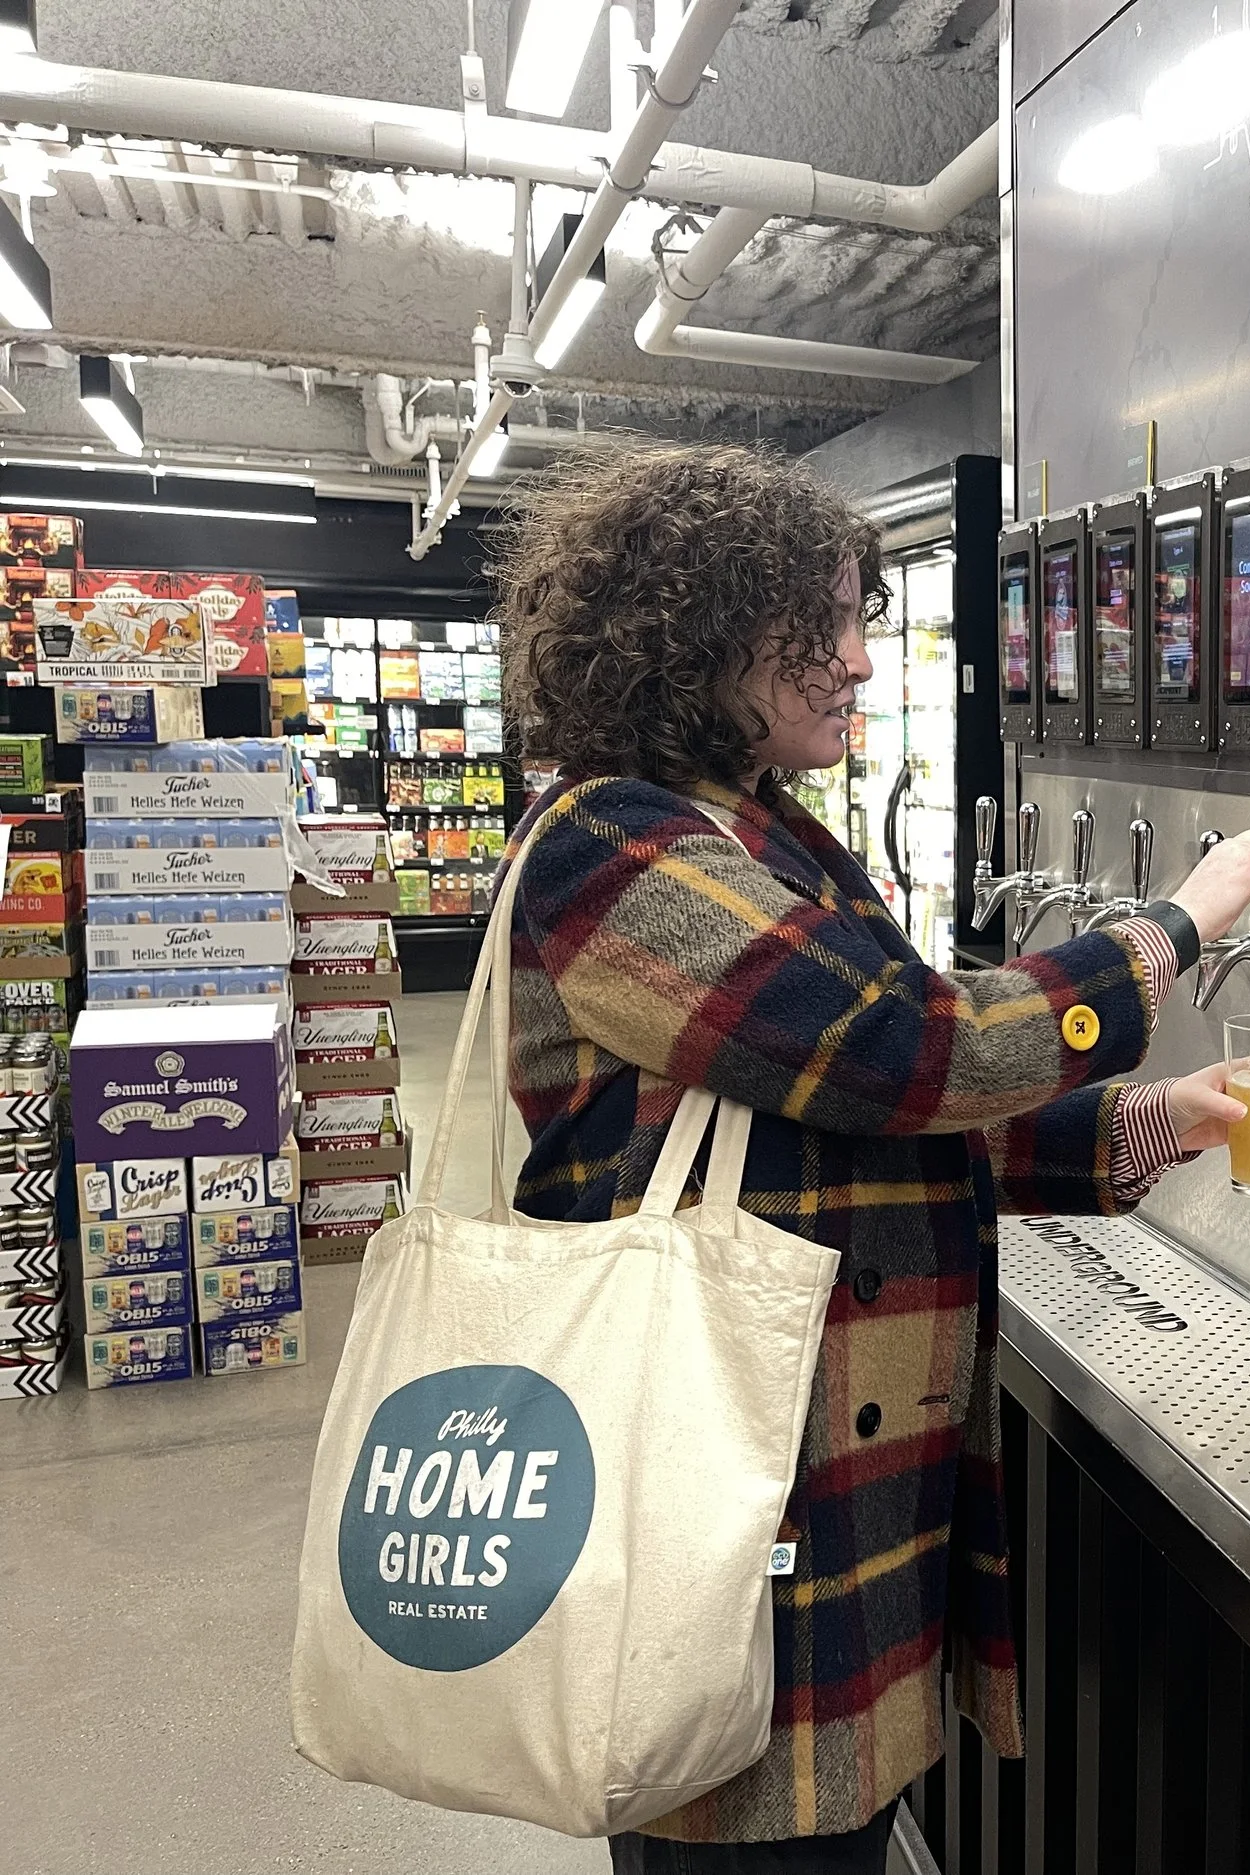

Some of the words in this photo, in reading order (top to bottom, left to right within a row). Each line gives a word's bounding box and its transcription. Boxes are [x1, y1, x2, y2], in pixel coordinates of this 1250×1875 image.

[49, 666, 98, 677] TROPICAL
[162, 775, 212, 795] Tucher
[131, 796, 166, 809] Helles
[171, 796, 198, 808] Hefe
[201, 795, 244, 810] Weizen
[163, 851, 214, 871] Tucher
[315, 849, 373, 869] uengling
[132, 872, 167, 884] Helles
[172, 871, 198, 883] Hefe
[202, 870, 245, 884] Weizen
[164, 928, 213, 947] Tucher
[297, 937, 376, 958] Yuengling
[132, 949, 167, 961] Helles
[172, 948, 197, 960] Hefe
[202, 947, 245, 959] Weizen
[5, 982, 54, 998] OVER
[297, 1027, 376, 1047] Yuengling
[104, 1080, 170, 1098] Samuel
[174, 1077, 239, 1095] Smith's
[104, 1104, 162, 1128] WINTER
[157, 1115, 186, 1127] ALE
[183, 1101, 245, 1123] WELCOME
[302, 1115, 380, 1135] Yuengling
[121, 1166, 179, 1194] Crisp
[200, 1175, 258, 1203] Crisp
[120, 1185, 182, 1213] Lager
[304, 1202, 383, 1223] Yuengling
[1019, 1216, 1189, 1333] UNDERGROUND
[437, 1406, 508, 1446] Philly
[364, 1445, 559, 1519] HOME
[378, 1531, 511, 1588] GIRLS
[388, 1600, 423, 1618] REAL
[428, 1603, 488, 1620] ESTATE
